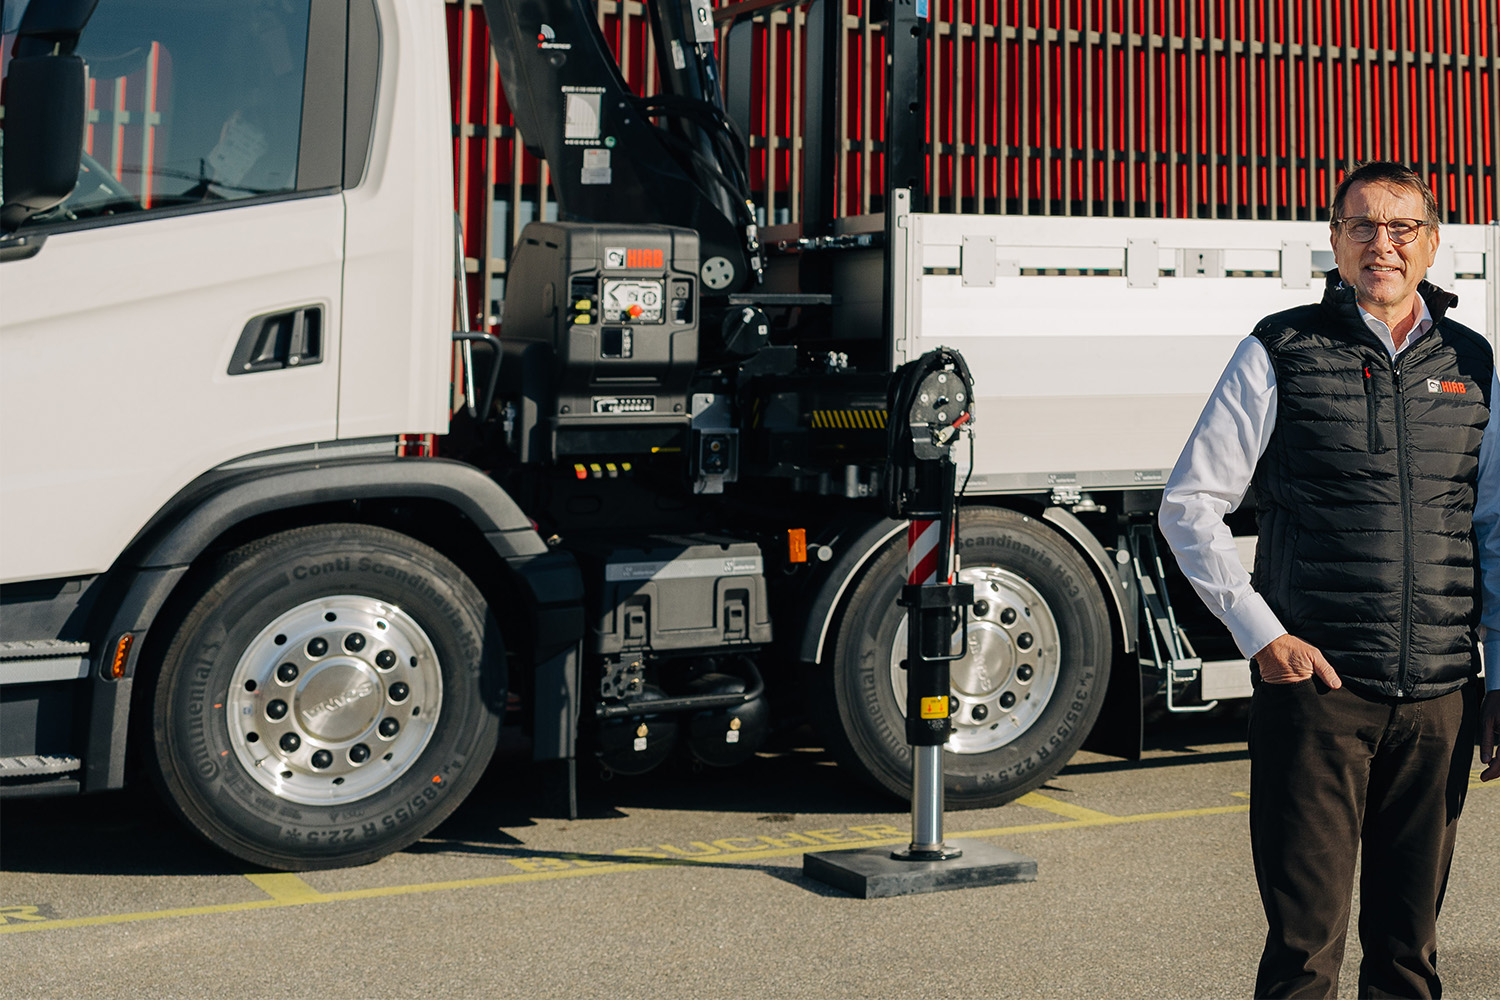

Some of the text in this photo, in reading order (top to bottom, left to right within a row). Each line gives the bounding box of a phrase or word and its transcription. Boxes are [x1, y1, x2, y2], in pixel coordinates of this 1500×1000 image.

[627, 248, 663, 268] HIAB
[1441, 381, 1466, 394] HIAB
[293, 556, 351, 580] Conti
[357, 557, 466, 630] Scandinavia
[1054, 564, 1079, 597] HS3
[998, 690, 1088, 783] 385/55 R 22.5
[382, 776, 448, 830] 385/55
[307, 827, 357, 845] 22.5
[361, 822, 378, 838] R
